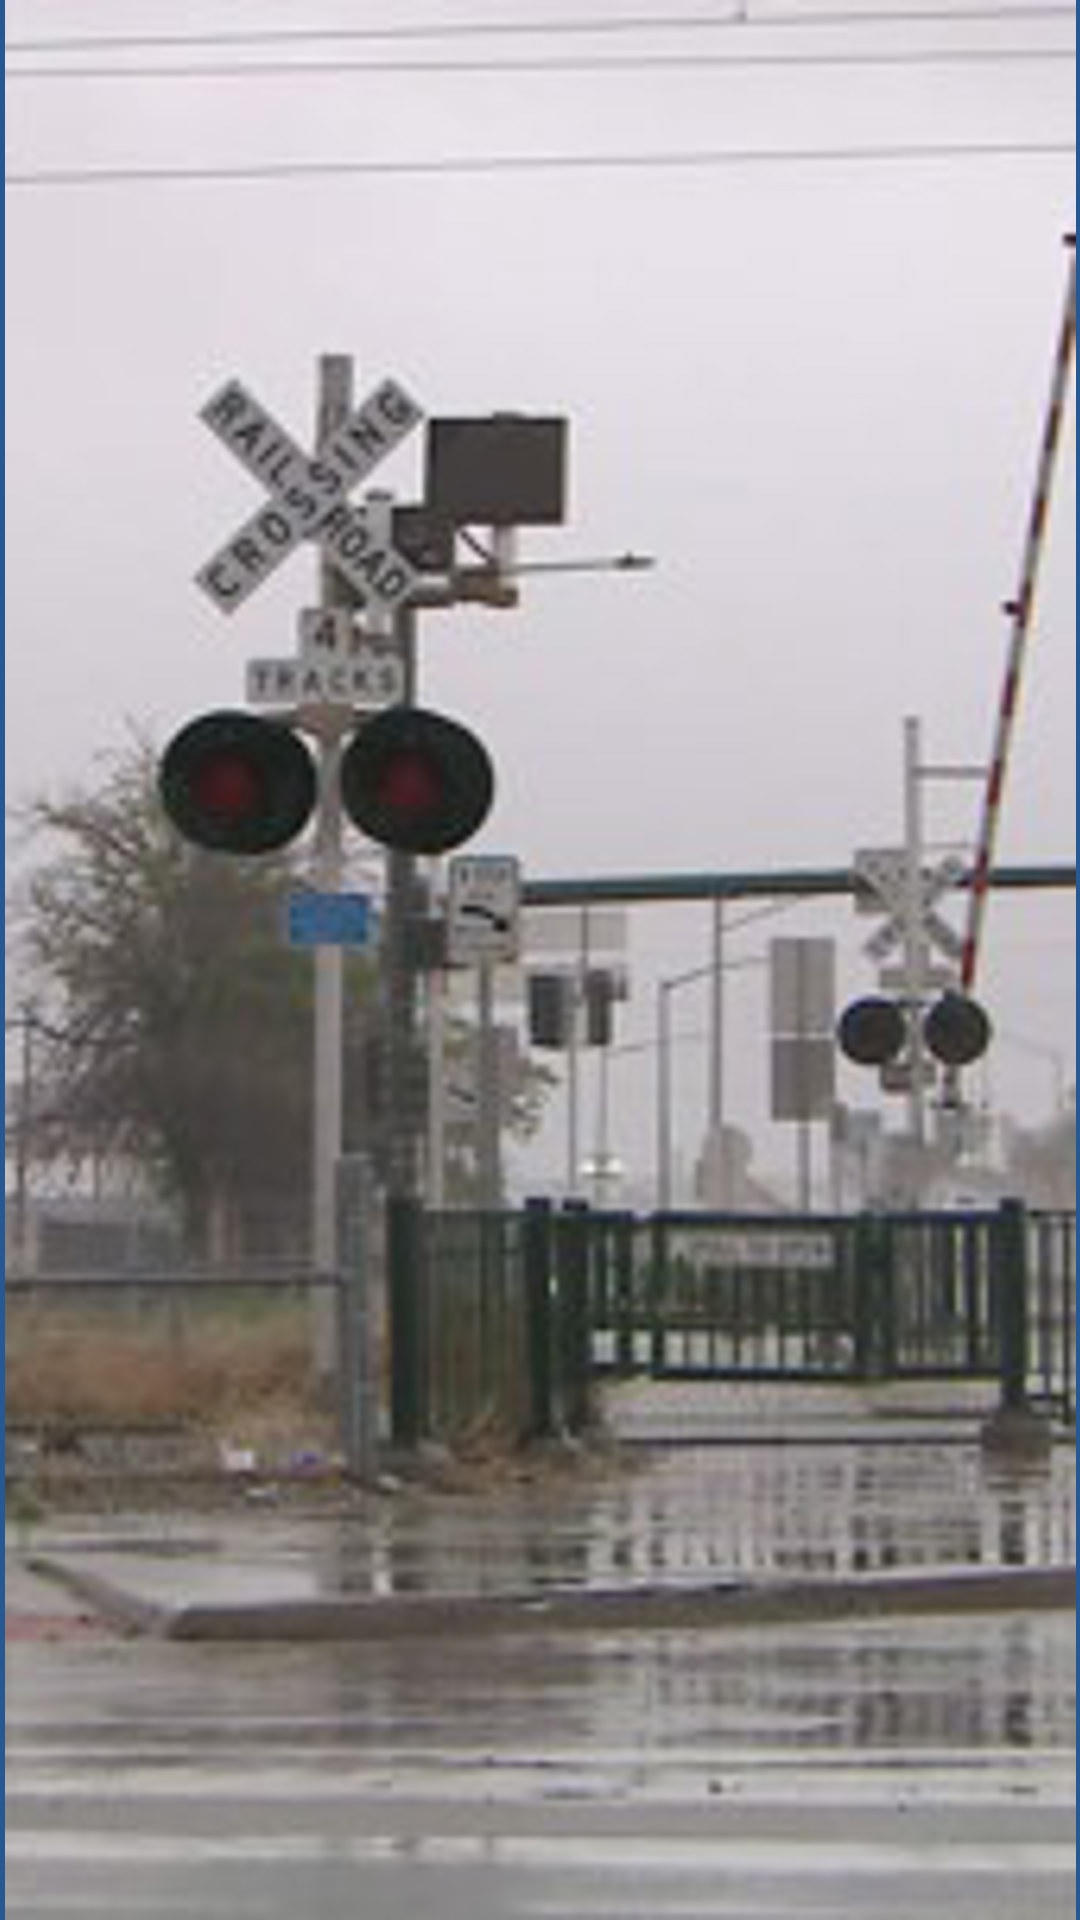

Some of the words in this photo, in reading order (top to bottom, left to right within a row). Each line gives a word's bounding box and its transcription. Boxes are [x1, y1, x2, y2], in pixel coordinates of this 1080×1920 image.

[206, 390, 409, 597] CROSSING
[211, 391, 292, 489] RAIL
[319, 504, 406, 598] ROAD
[252, 667, 399, 694] TRACKS
[313, 615, 337, 650] 4
